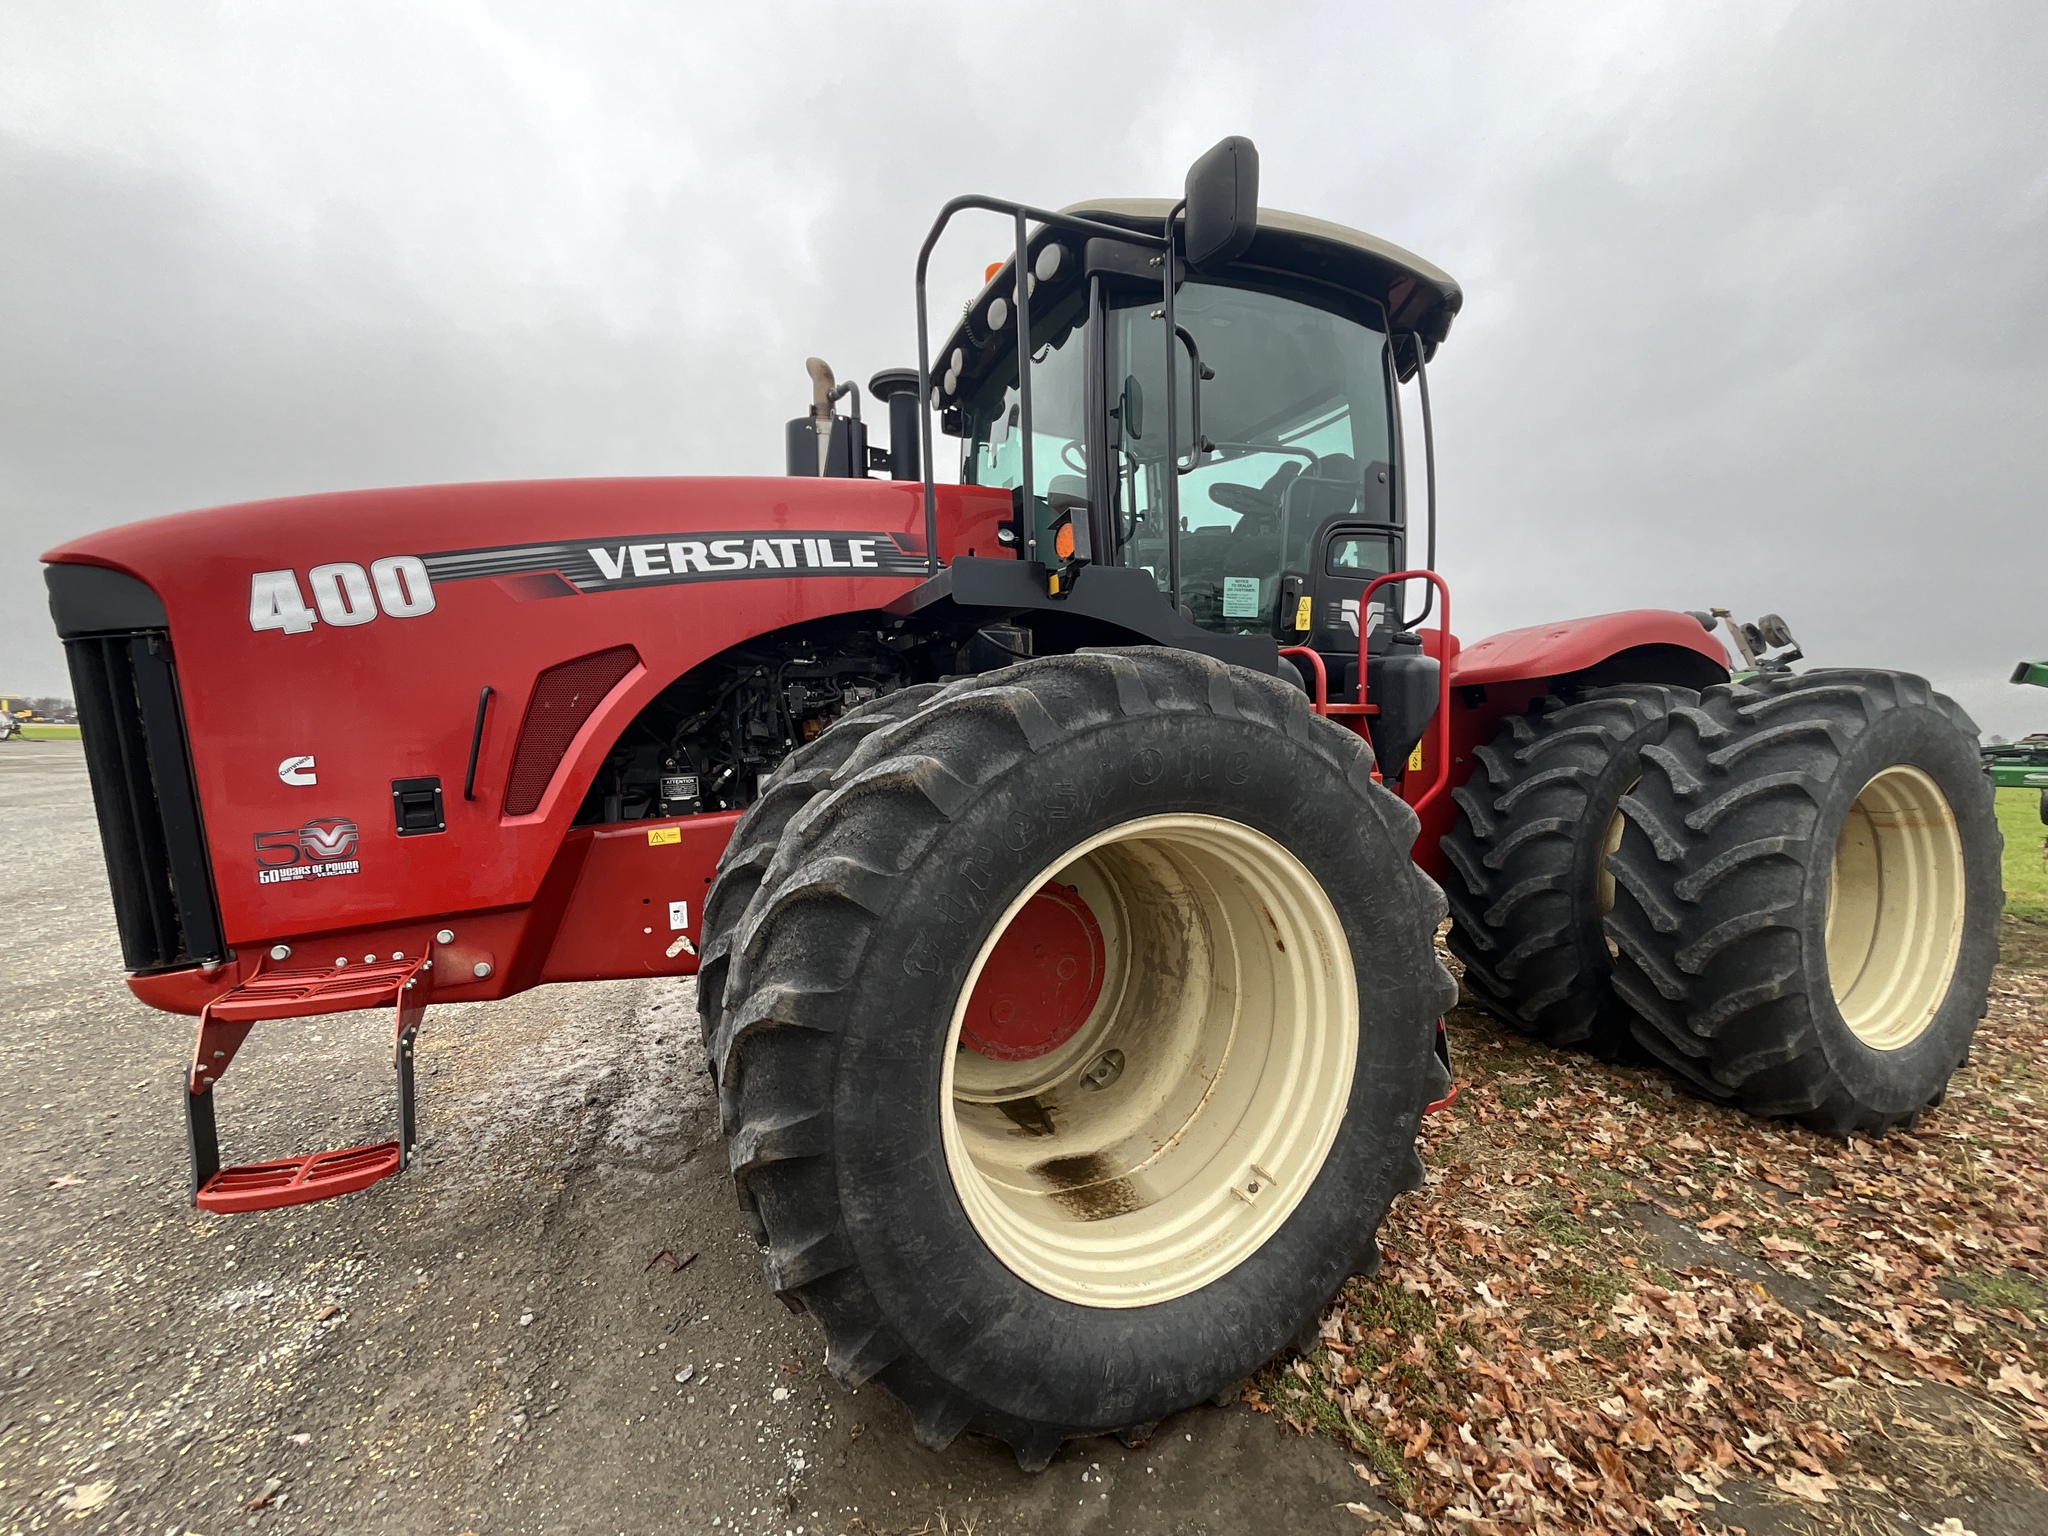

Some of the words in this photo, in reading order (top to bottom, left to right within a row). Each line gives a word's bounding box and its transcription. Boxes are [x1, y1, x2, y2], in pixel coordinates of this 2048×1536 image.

[587, 538, 879, 580] VERSATILE
[249, 555, 437, 635] 400
[280, 756, 311, 776] Cummins
[259, 868, 280, 884] 50
[312, 864, 325, 874] OF
[317, 868, 360, 877] VERSATILE
